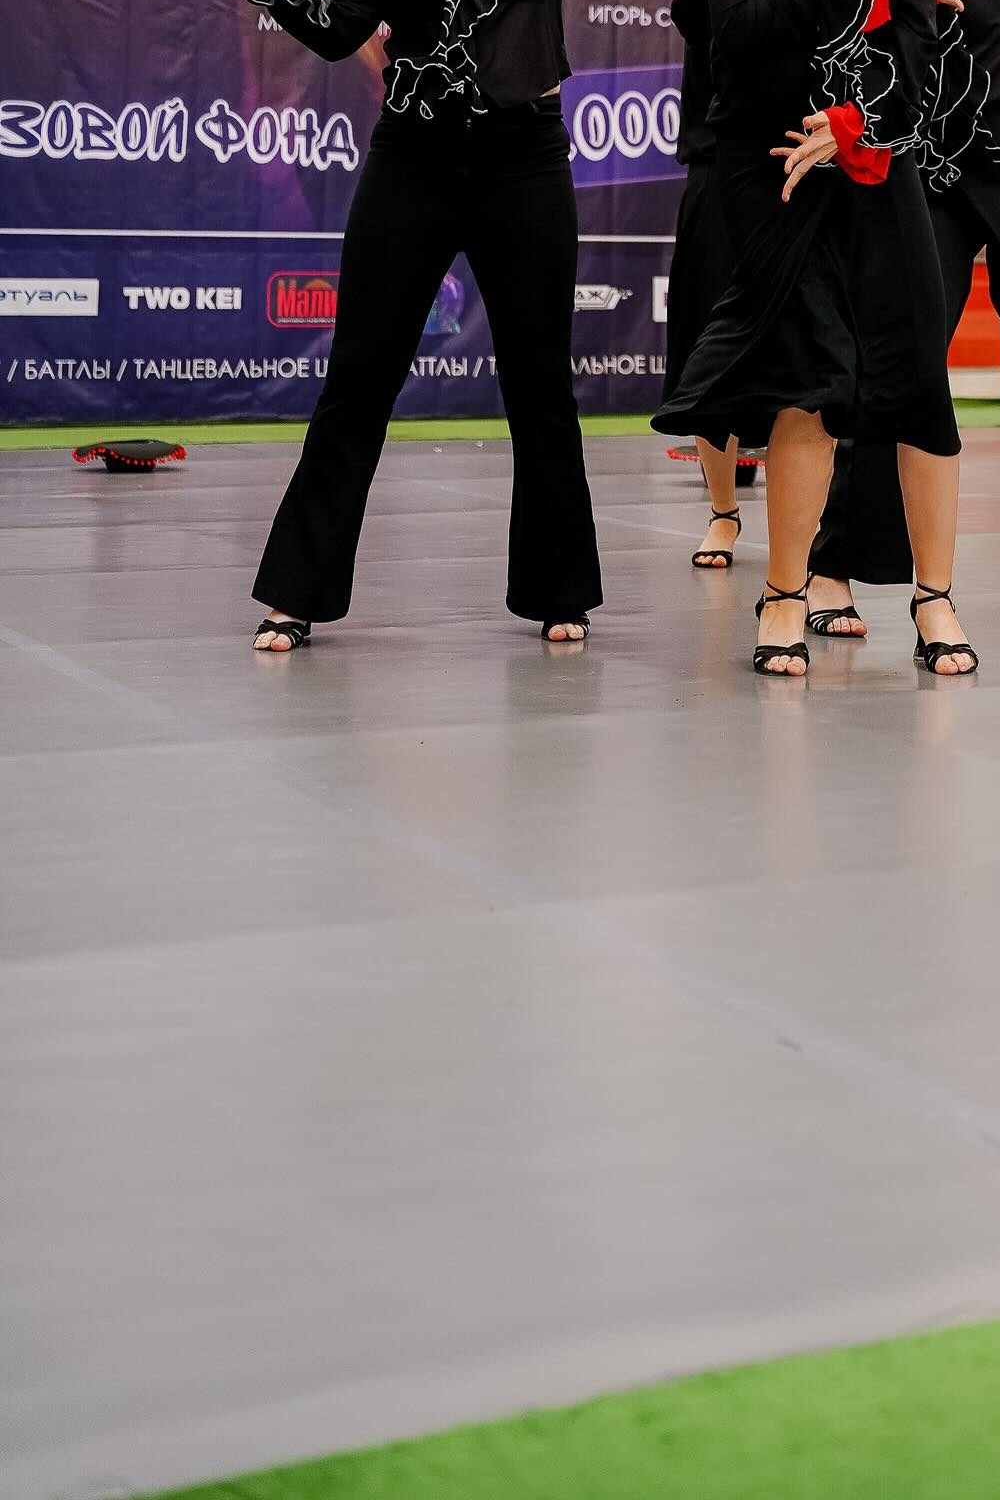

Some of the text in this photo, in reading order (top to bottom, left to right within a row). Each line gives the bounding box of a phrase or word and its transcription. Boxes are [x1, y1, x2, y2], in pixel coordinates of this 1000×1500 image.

[588, 4, 652, 27] ИГОРЬ
[122, 286, 243, 310] TWO KEI
[277, 279, 337, 318] Мали
[24, 358, 111, 380] БАТТЛЫ
[132, 357, 310, 381] ТАНЦЕВАЛЬНОЕ
[409, 355, 468, 377] АТТЛЫ
